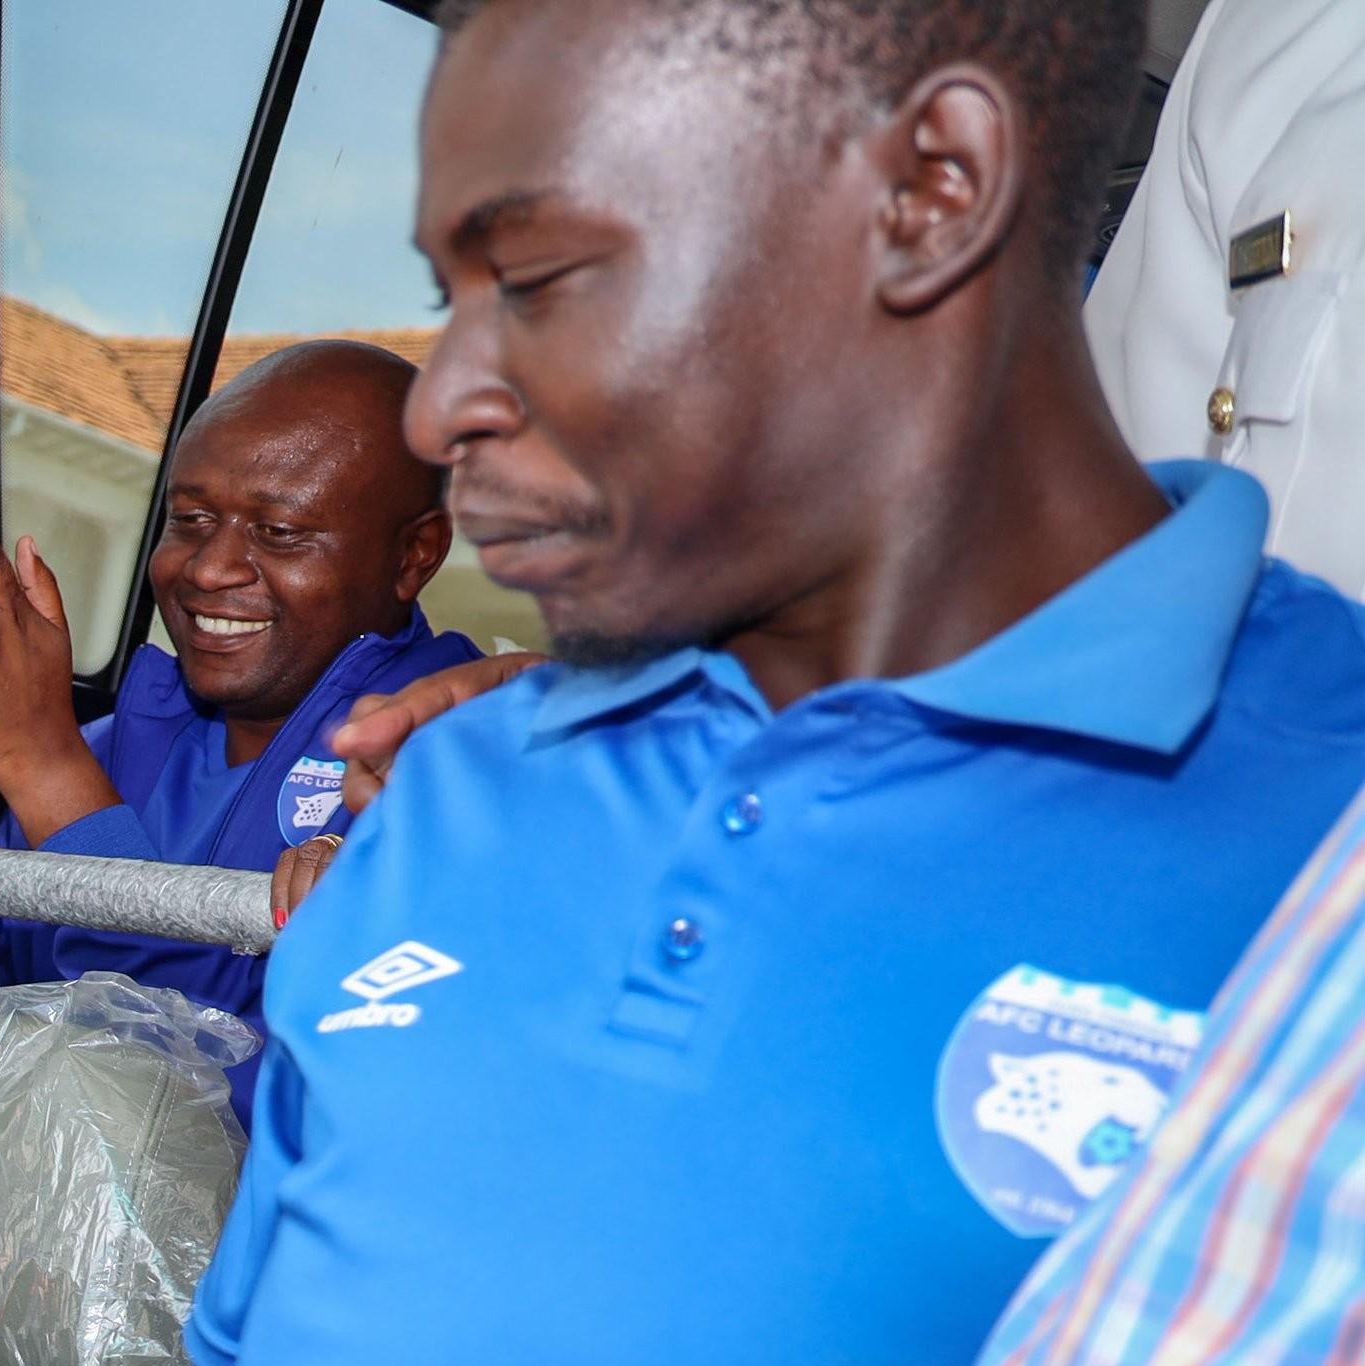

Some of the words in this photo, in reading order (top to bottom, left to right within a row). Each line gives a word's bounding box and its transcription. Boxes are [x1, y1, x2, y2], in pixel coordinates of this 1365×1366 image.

[287, 775, 313, 785] AFC
[315, 778, 342, 788] LEO
[975, 1002, 1044, 1034] AFC
